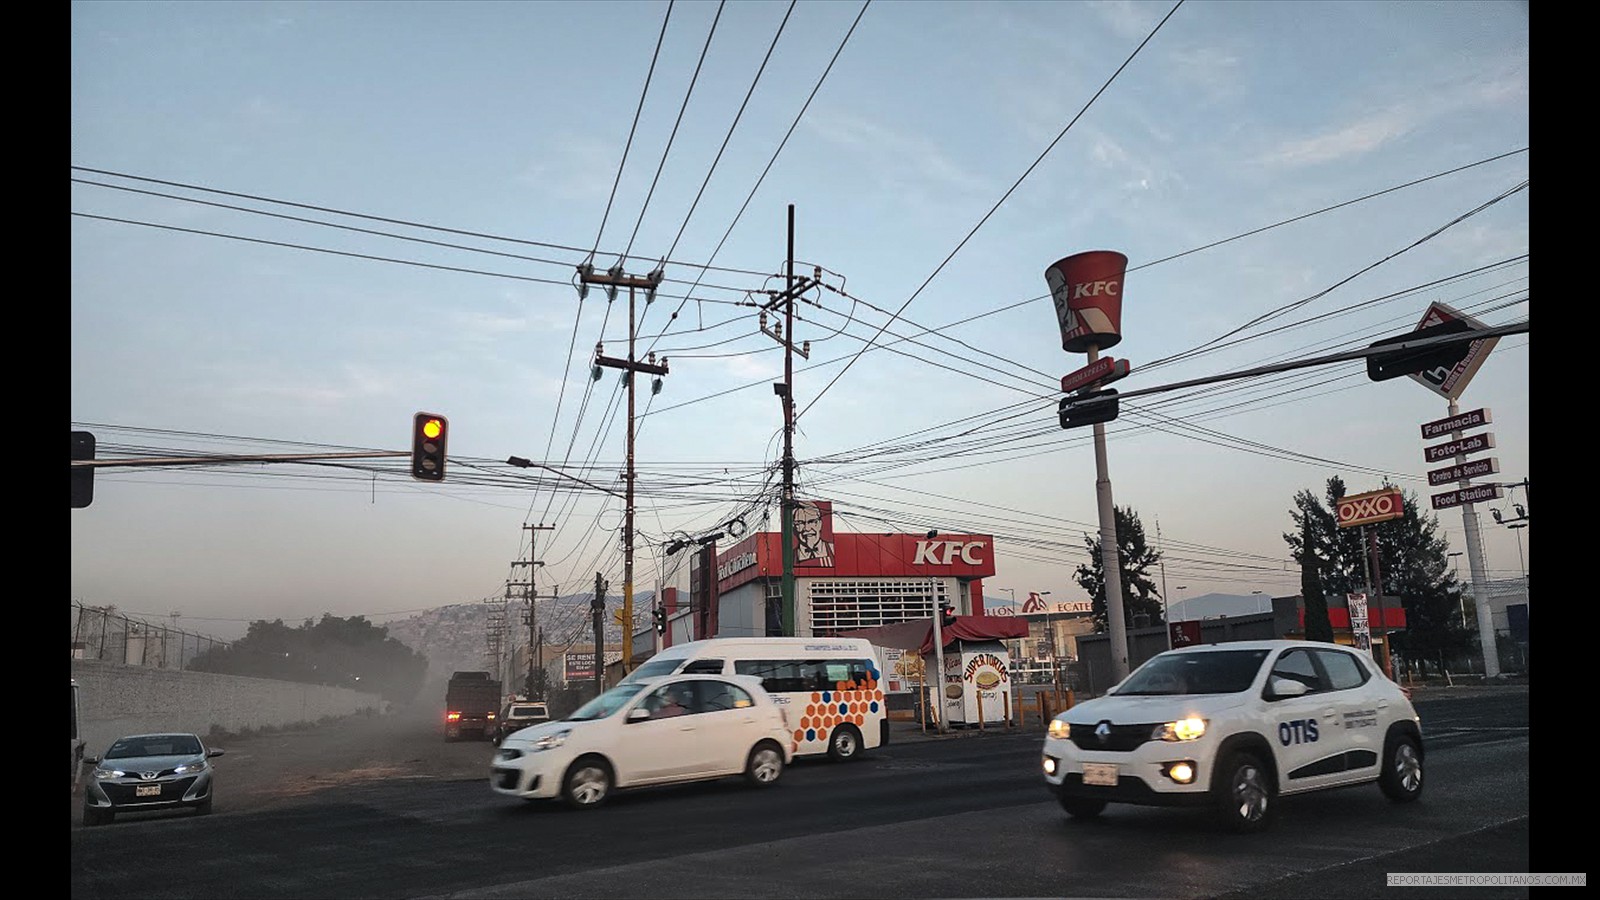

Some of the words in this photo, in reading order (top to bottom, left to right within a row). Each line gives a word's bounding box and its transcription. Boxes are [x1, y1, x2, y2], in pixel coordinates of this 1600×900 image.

[1073, 281, 1118, 299] KFC
[1424, 414, 1480, 435] Farmacia
[1430, 438, 1482, 458] Foto-Lab
[1432, 472, 1452, 482] Centro
[1454, 468, 1462, 477] de
[1463, 462, 1489, 476] Servicio
[1435, 493, 1457, 506] Food
[1460, 488, 1493, 501] Station
[1339, 496, 1393, 520] OXXO
[912, 540, 985, 565] KFC
[963, 653, 986, 684] SUPER
[985, 653, 1011, 684] TORTAS
[1278, 718, 1319, 747] OTIS
